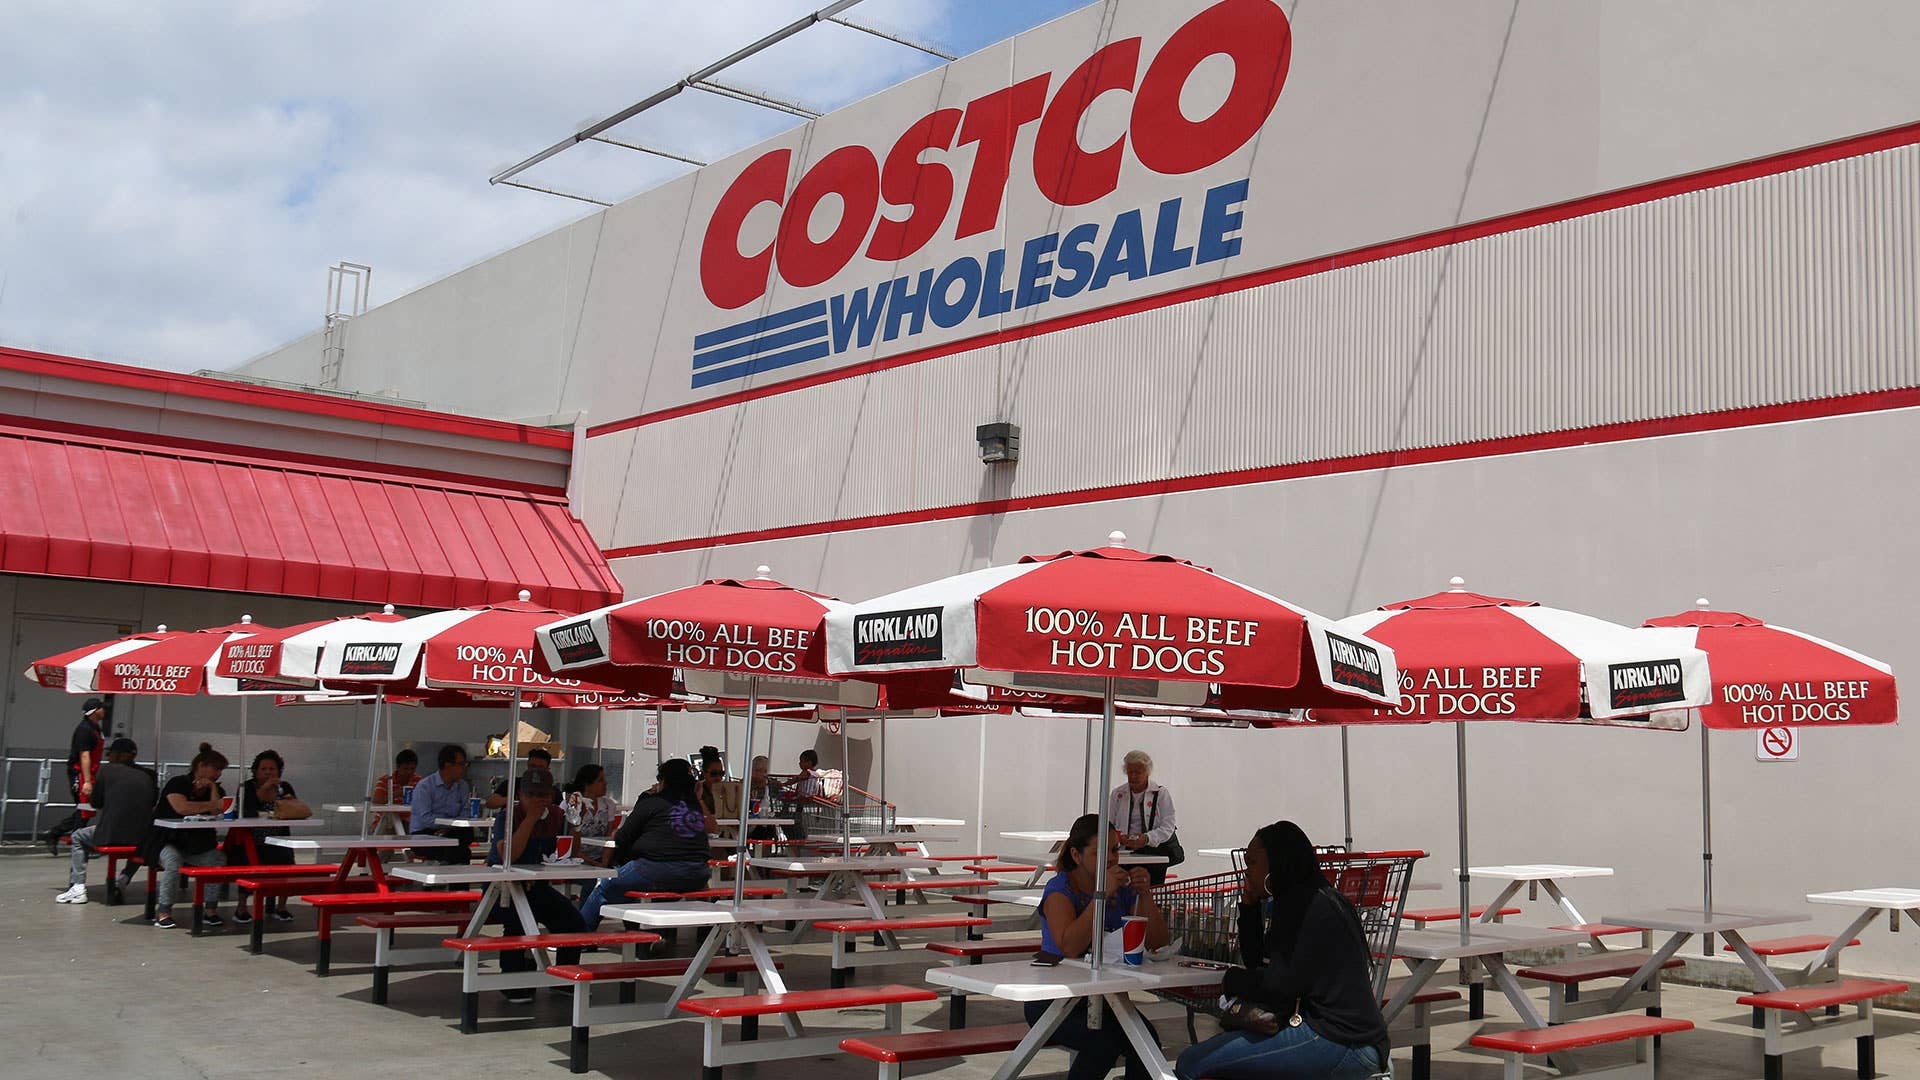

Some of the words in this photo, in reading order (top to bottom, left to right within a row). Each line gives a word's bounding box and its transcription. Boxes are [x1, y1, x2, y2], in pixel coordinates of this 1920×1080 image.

[699, 0, 1291, 309] COSTCO
[829, 178, 1250, 354] WHOLESALE
[551, 624, 594, 650] KIRKLAND
[646, 618, 706, 642] 100%
[712, 624, 759, 646] ALL
[767, 627, 816, 650] BEE
[858, 613, 938, 643] KIRKLAND
[1024, 606, 1104, 637] 100%
[1113, 613, 1175, 641] ALL
[1186, 617, 1259, 647] BEEF
[244, 645, 257, 658] ALL
[257, 644, 274, 658] BEEF
[345, 646, 398, 662] KIRKLAND
[456, 645, 506, 663] 100%
[666, 643, 719, 665] HOT
[726, 648, 797, 672] DOGS
[858, 642, 937, 665] Signature
[1050, 639, 1122, 669] HOT
[1131, 644, 1225, 675] DOGS
[1329, 637, 1380, 675] KIRKLAND
[114, 664, 140, 677] 100%
[142, 665, 162, 677] ALL
[166, 666, 191, 678] BEEF
[230, 660, 245, 673] HOT
[244, 660, 265, 674] DOGS
[472, 664, 518, 682] HOT
[1422, 667, 1472, 690] ALL
[1481, 667, 1542, 689] BEEF
[1612, 664, 1680, 690] KIRKLAND
[122, 678, 145, 690] HOT
[145, 679, 177, 691] DOGS
[1722, 683, 1773, 703] 100%
[1779, 682, 1817, 701] ALL
[1824, 681, 1869, 699] BEEF
[1373, 693, 1432, 716] OT
[1438, 692, 1516, 715] DOGS
[1742, 704, 1786, 724] HOT
[1792, 702, 1851, 722] DOGS
